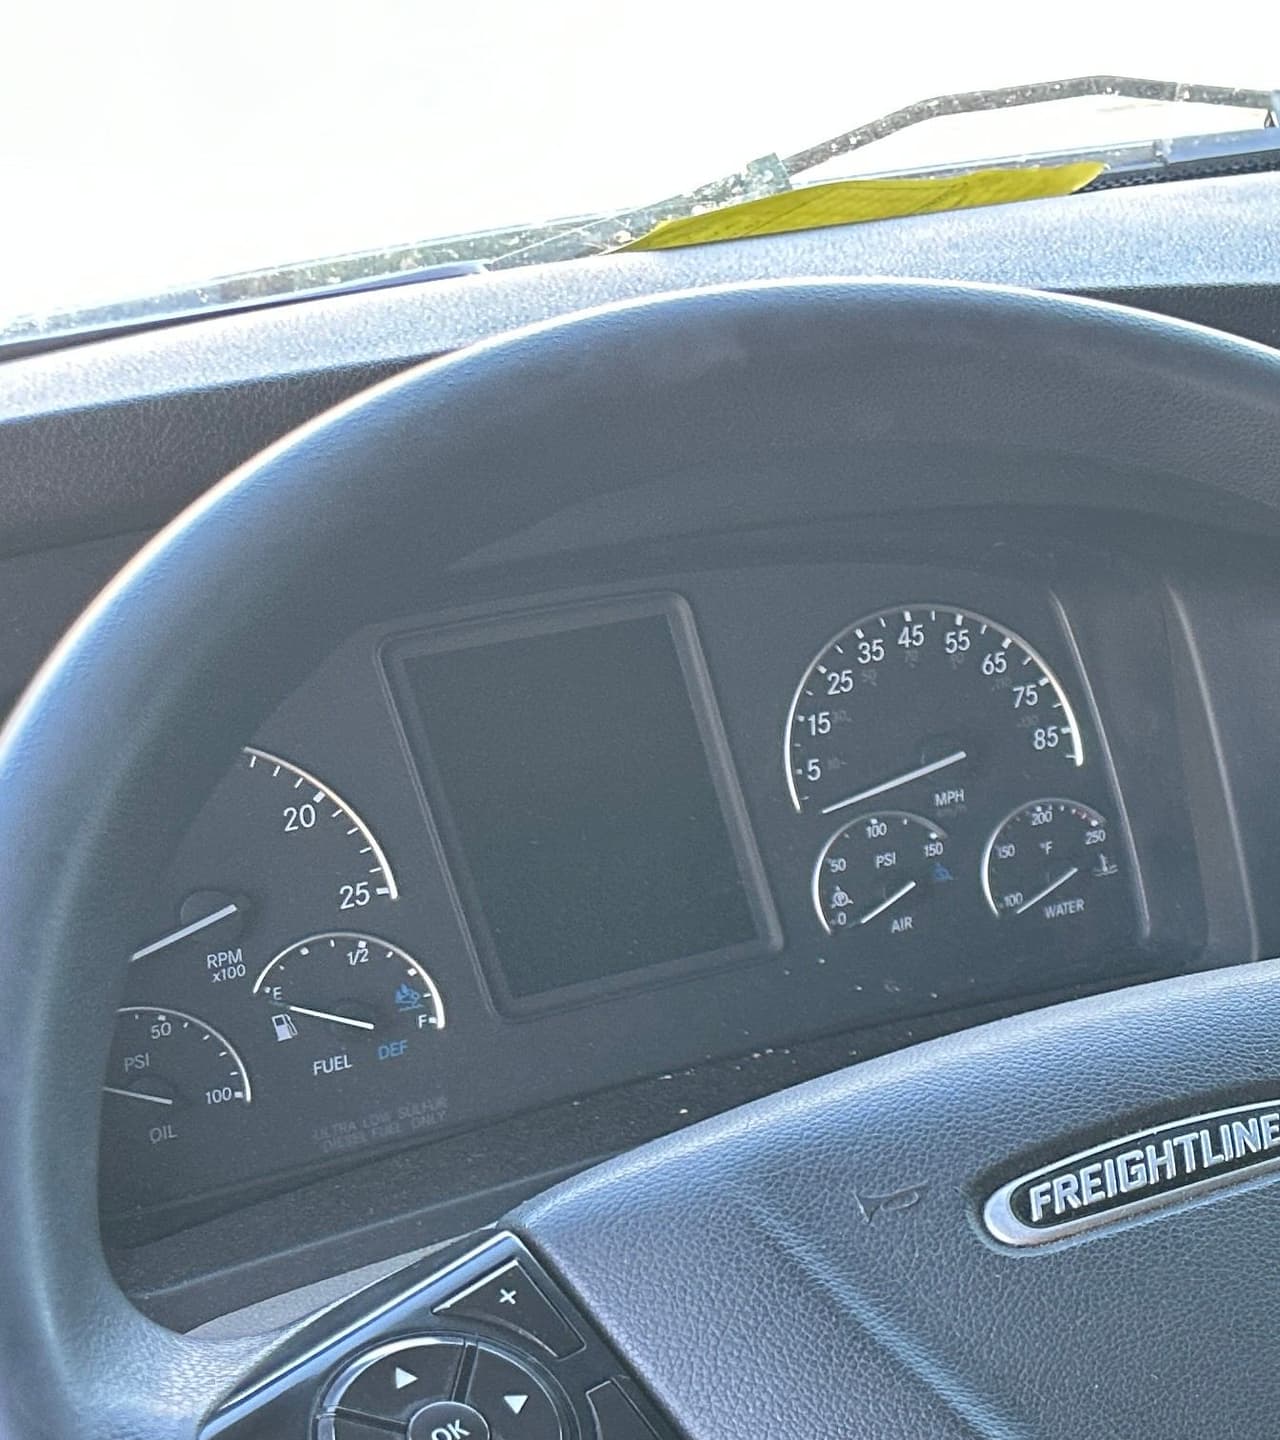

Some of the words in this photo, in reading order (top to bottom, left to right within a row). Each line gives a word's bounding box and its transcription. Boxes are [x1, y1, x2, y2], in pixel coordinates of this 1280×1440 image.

[897, 624, 925, 648] 45
[944, 630, 970, 654] 55
[857, 640, 885, 665] 35
[982, 652, 1008, 676] 65
[827, 670, 854, 696] 25
[1012, 685, 1038, 708] 75
[808, 712, 831, 736] 15
[1033, 726, 1059, 750] 85
[807, 759, 821, 781] 5
[934, 788, 965, 806] MPH
[283, 803, 316, 831] 20
[1031, 811, 1052, 826] 200
[866, 824, 888, 838] 100
[1085, 830, 1107, 845] 250
[923, 842, 944, 857] 150
[996, 845, 1016, 859] 150
[830, 859, 847, 873] 50
[875, 853, 896, 868] PSI
[339, 881, 370, 909] 25
[1003, 893, 1023, 906] 100
[837, 912, 847, 925] 0
[1044, 899, 1085, 919] WATER
[891, 917, 914, 933] AIR
[207, 948, 242, 968] RPM
[347, 949, 370, 966] 1/2
[212, 964, 246, 983] x100
[273, 987, 283, 1000] E
[151, 1022, 171, 1039] 50
[418, 1015, 427, 1028] F
[377, 1040, 409, 1060] DEF
[124, 1053, 151, 1072] PSI
[313, 1055, 352, 1076] FUEL
[205, 1087, 232, 1104] 100
[149, 1125, 177, 1144] OIL
